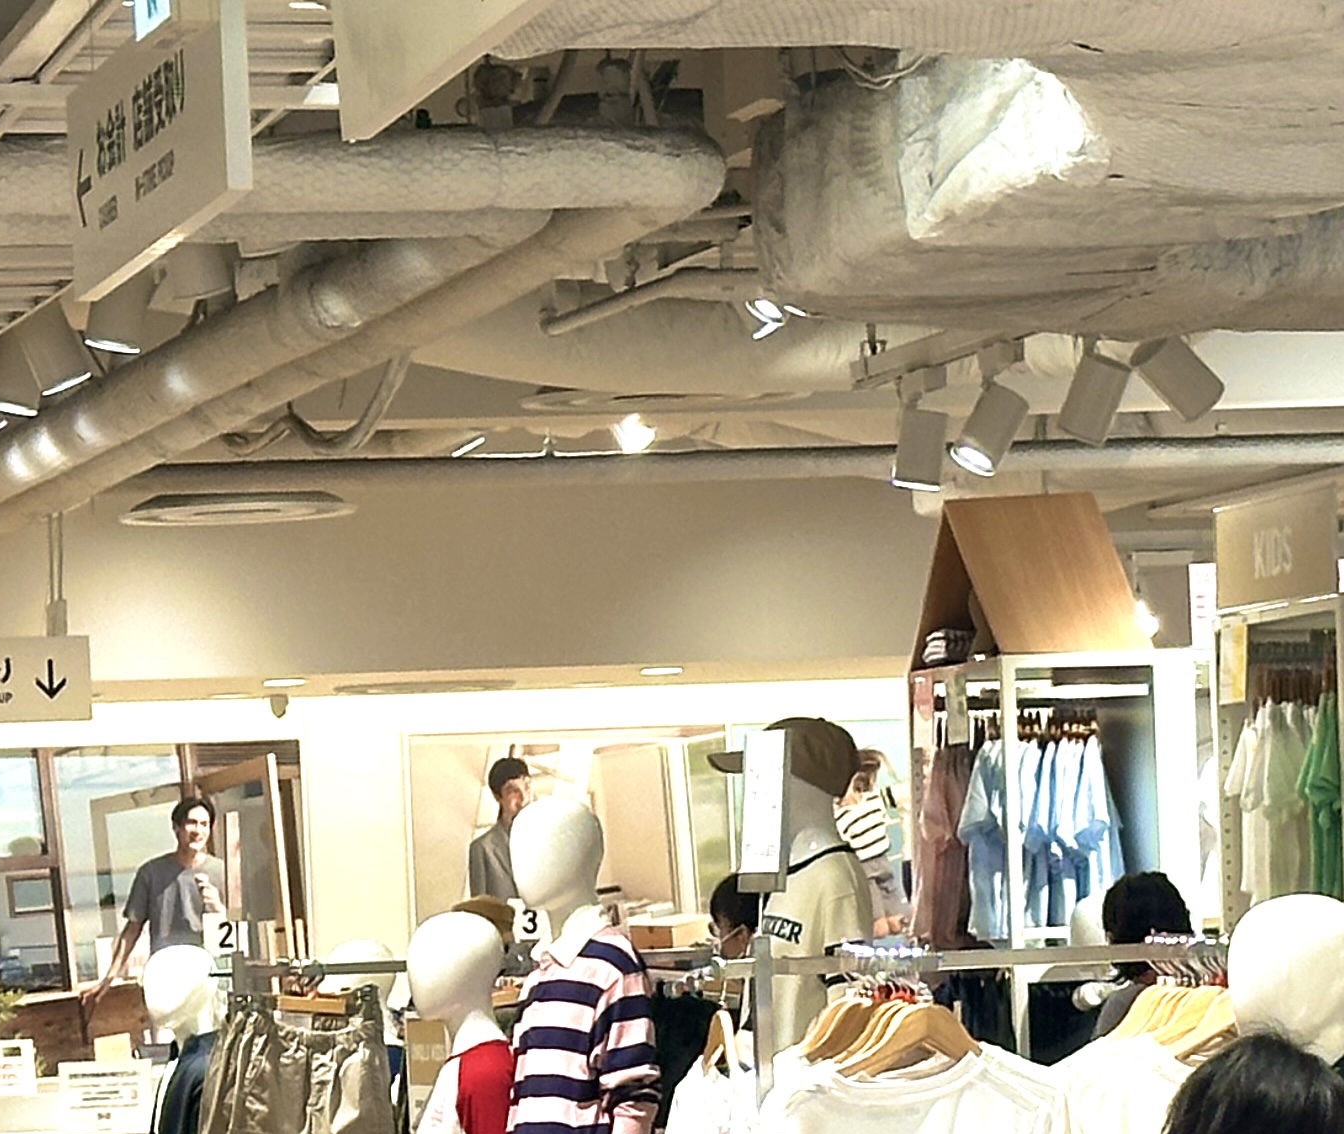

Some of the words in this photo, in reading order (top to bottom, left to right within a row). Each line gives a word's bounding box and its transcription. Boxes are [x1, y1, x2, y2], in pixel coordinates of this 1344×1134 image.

[1254, 525, 1293, 580] KIDS
[218, 920, 234, 949] 2
[521, 908, 538, 934] 3
